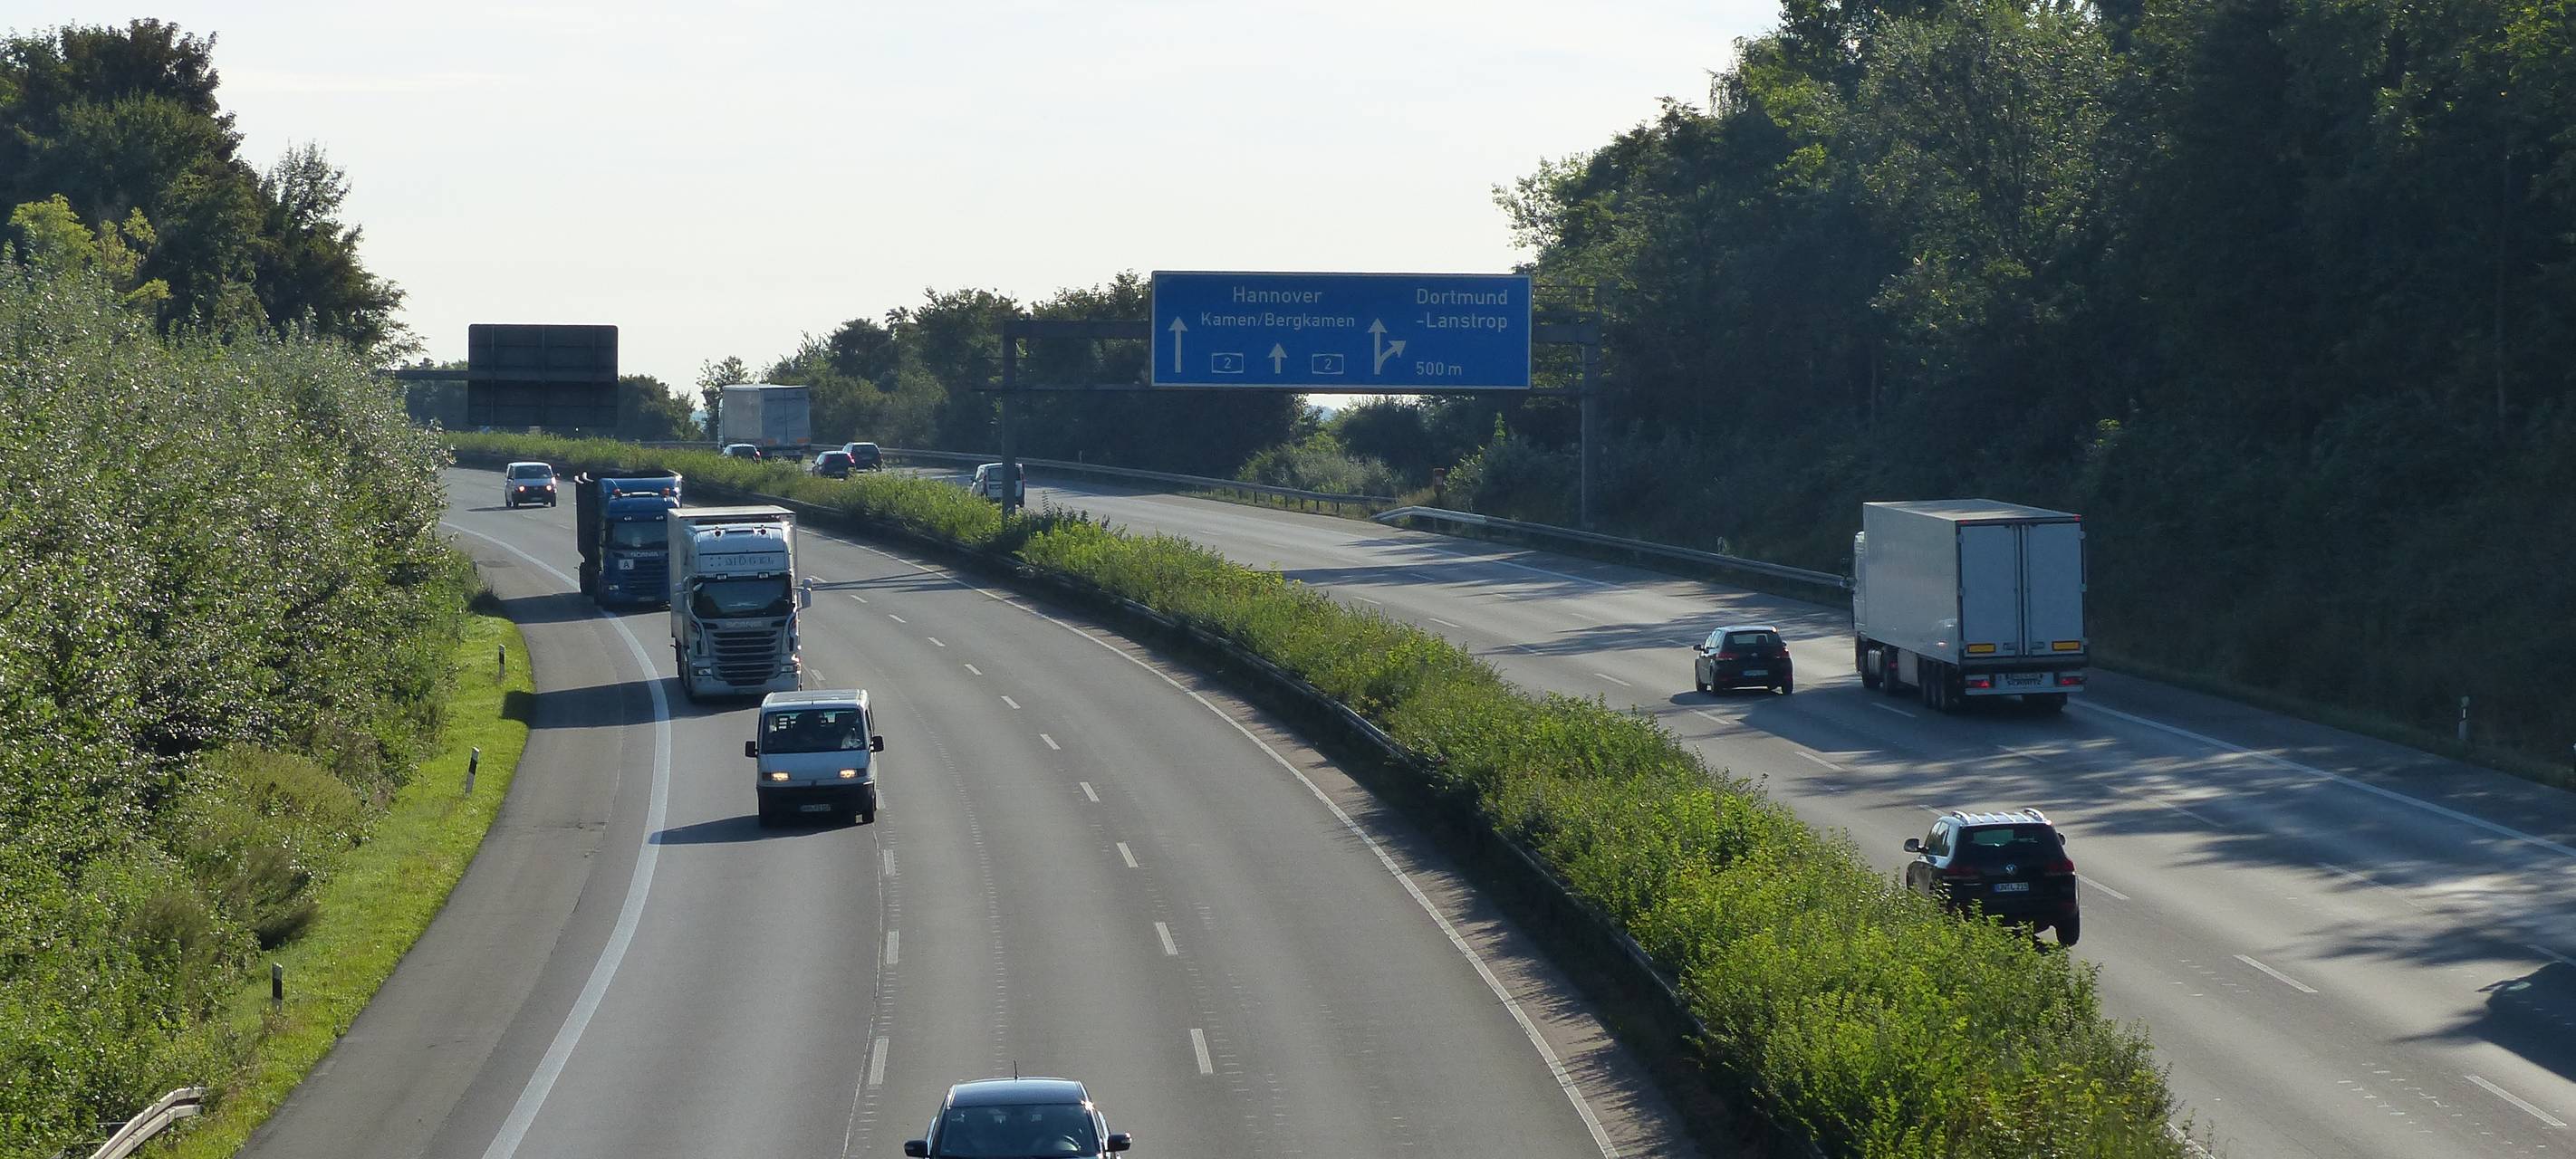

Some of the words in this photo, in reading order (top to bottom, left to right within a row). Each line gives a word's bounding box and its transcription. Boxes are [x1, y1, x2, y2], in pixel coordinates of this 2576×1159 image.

[1233, 286, 1322, 304] Hannover
[1417, 288, 1508, 305] Dortmund
[1201, 312, 1355, 330] Kamen/Bergkamen
[1416, 312, 1508, 331] -Lanstrop
[1224, 358, 1232, 370] 2
[1324, 358, 1332, 370] 2
[1416, 361, 1445, 376] 500
[1447, 365, 1463, 376] m
